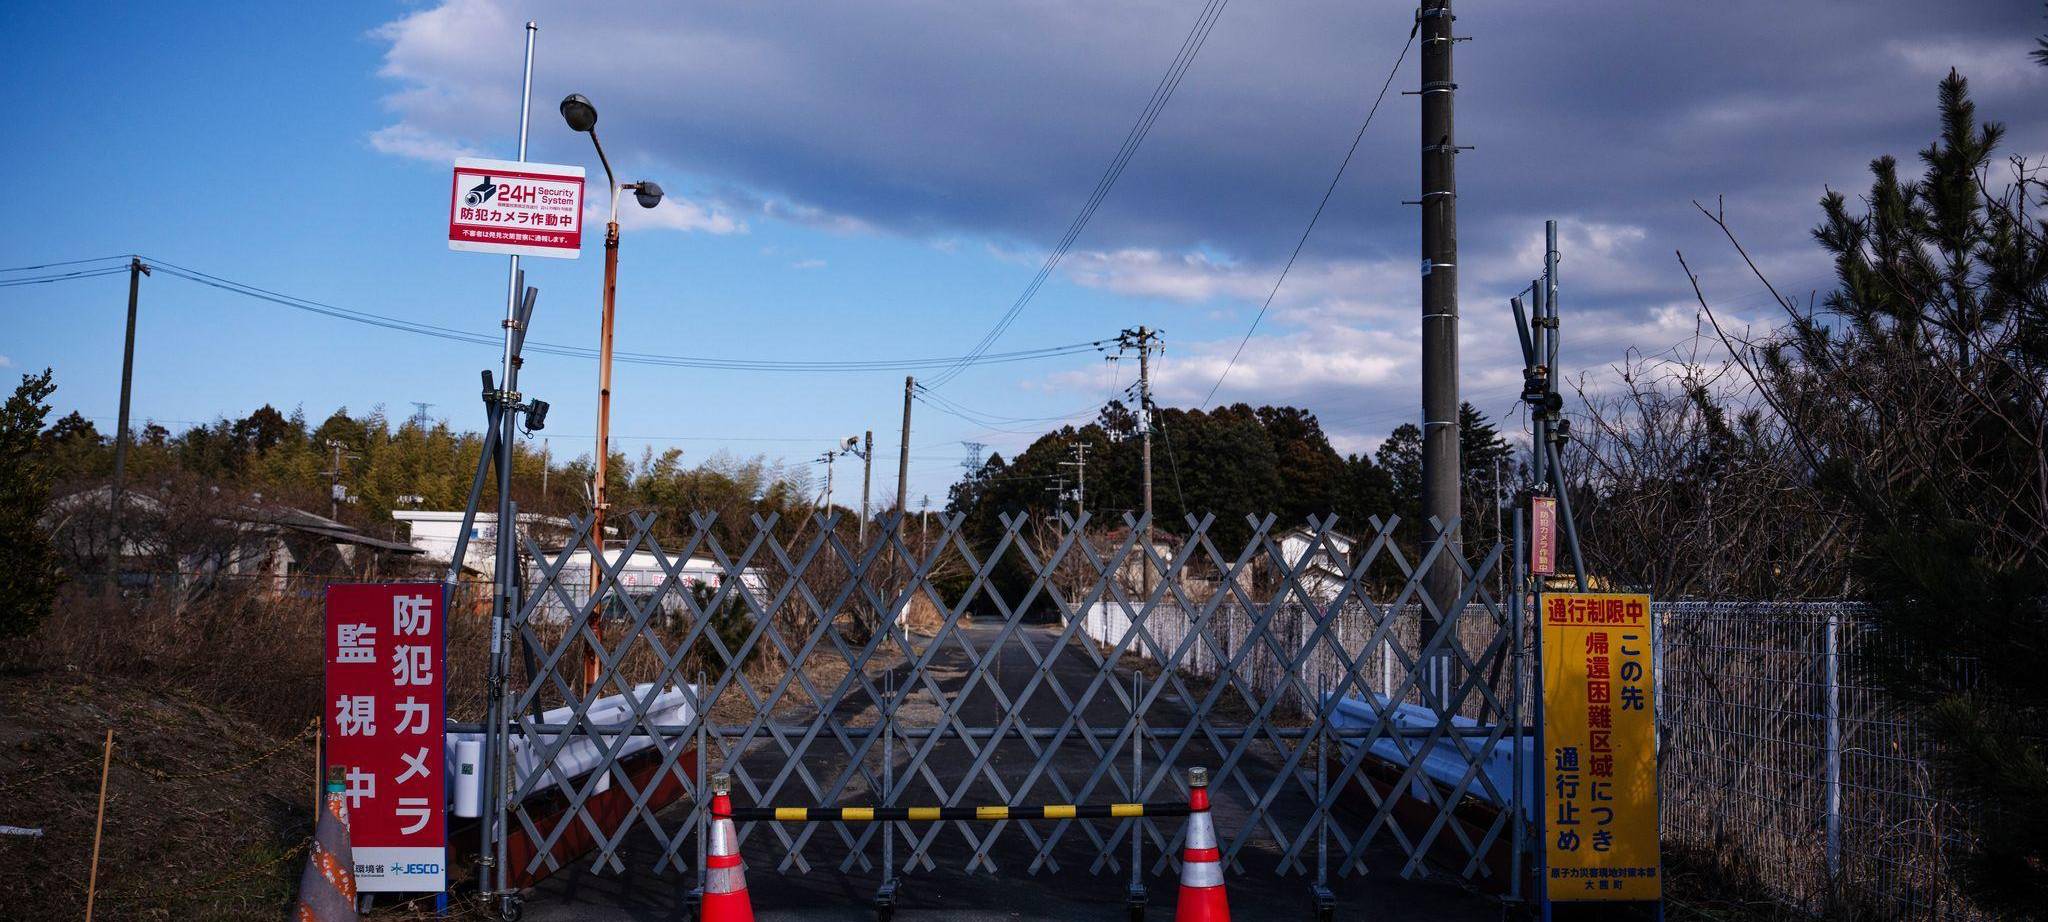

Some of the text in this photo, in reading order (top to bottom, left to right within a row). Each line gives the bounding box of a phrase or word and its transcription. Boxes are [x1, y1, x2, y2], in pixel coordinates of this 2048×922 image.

[498, 183, 537, 204] 24H
[538, 187, 574, 197] Security
[542, 196, 574, 205] System
[460, 207, 573, 227] 防犯カメラ作動中
[1548, 599, 1643, 624] 通行制限中
[1620, 635, 1645, 711] この先
[336, 623, 377, 808] 監視中
[392, 594, 434, 835] 防犯カメラ
[1586, 632, 1614, 852] 帰還困難区域につき
[1555, 747, 1580, 852] 通行止め
[403, 864, 439, 874] JESCO
